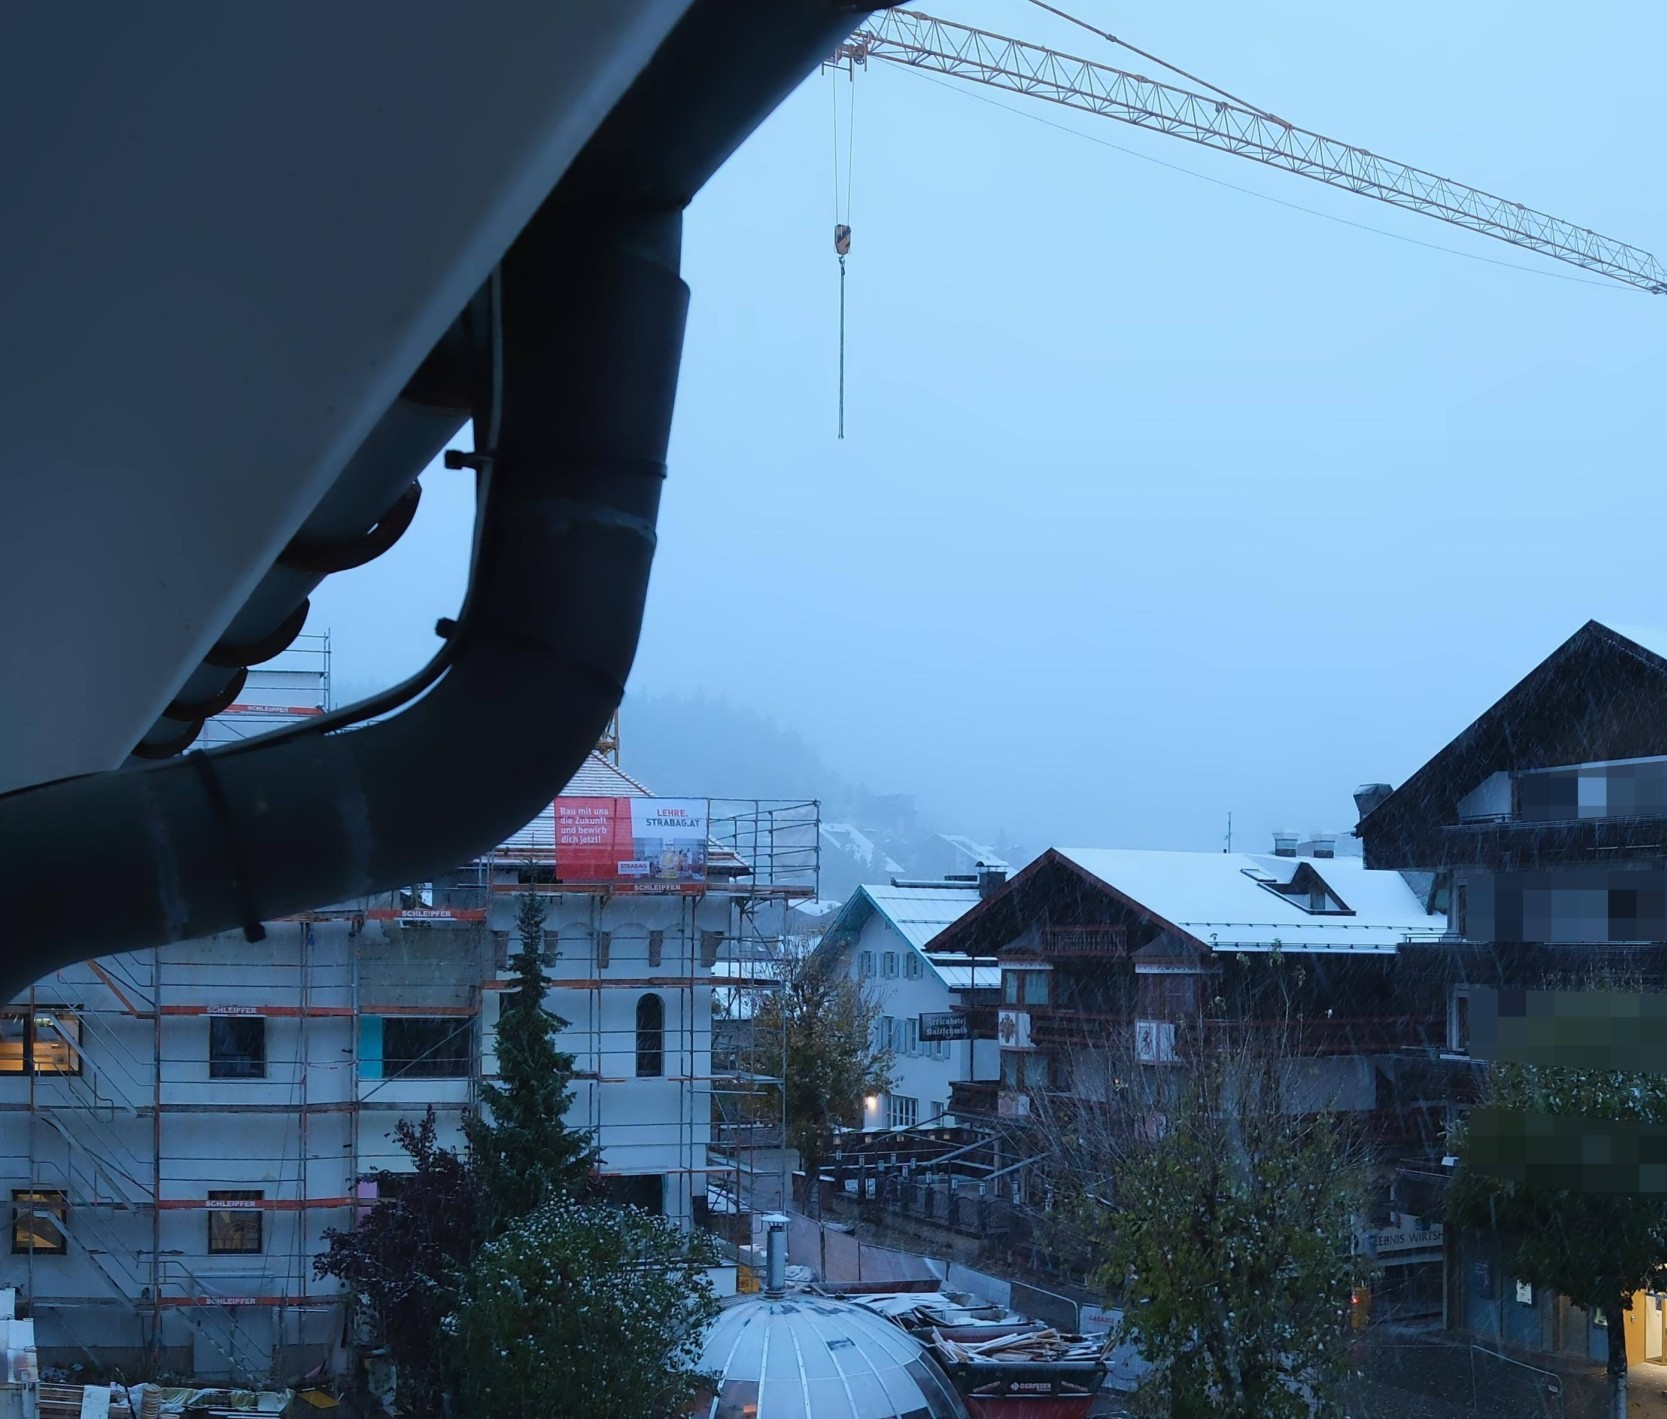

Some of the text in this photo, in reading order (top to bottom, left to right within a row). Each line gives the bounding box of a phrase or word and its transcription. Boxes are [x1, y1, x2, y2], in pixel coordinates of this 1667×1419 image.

[560, 807, 575, 815] Bau
[578, 807, 592, 815] mit
[657, 809, 688, 818] LEHRE.
[560, 816, 607, 825] die Zukunft
[646, 818, 700, 828] STRABAG.AT
[561, 826, 607, 834] und bewirb
[561, 835, 601, 845] dich jetzt!
[206, 1006, 257, 1014] SCHLEIPFER
[206, 1200, 256, 1208] SCHLEIPFER
